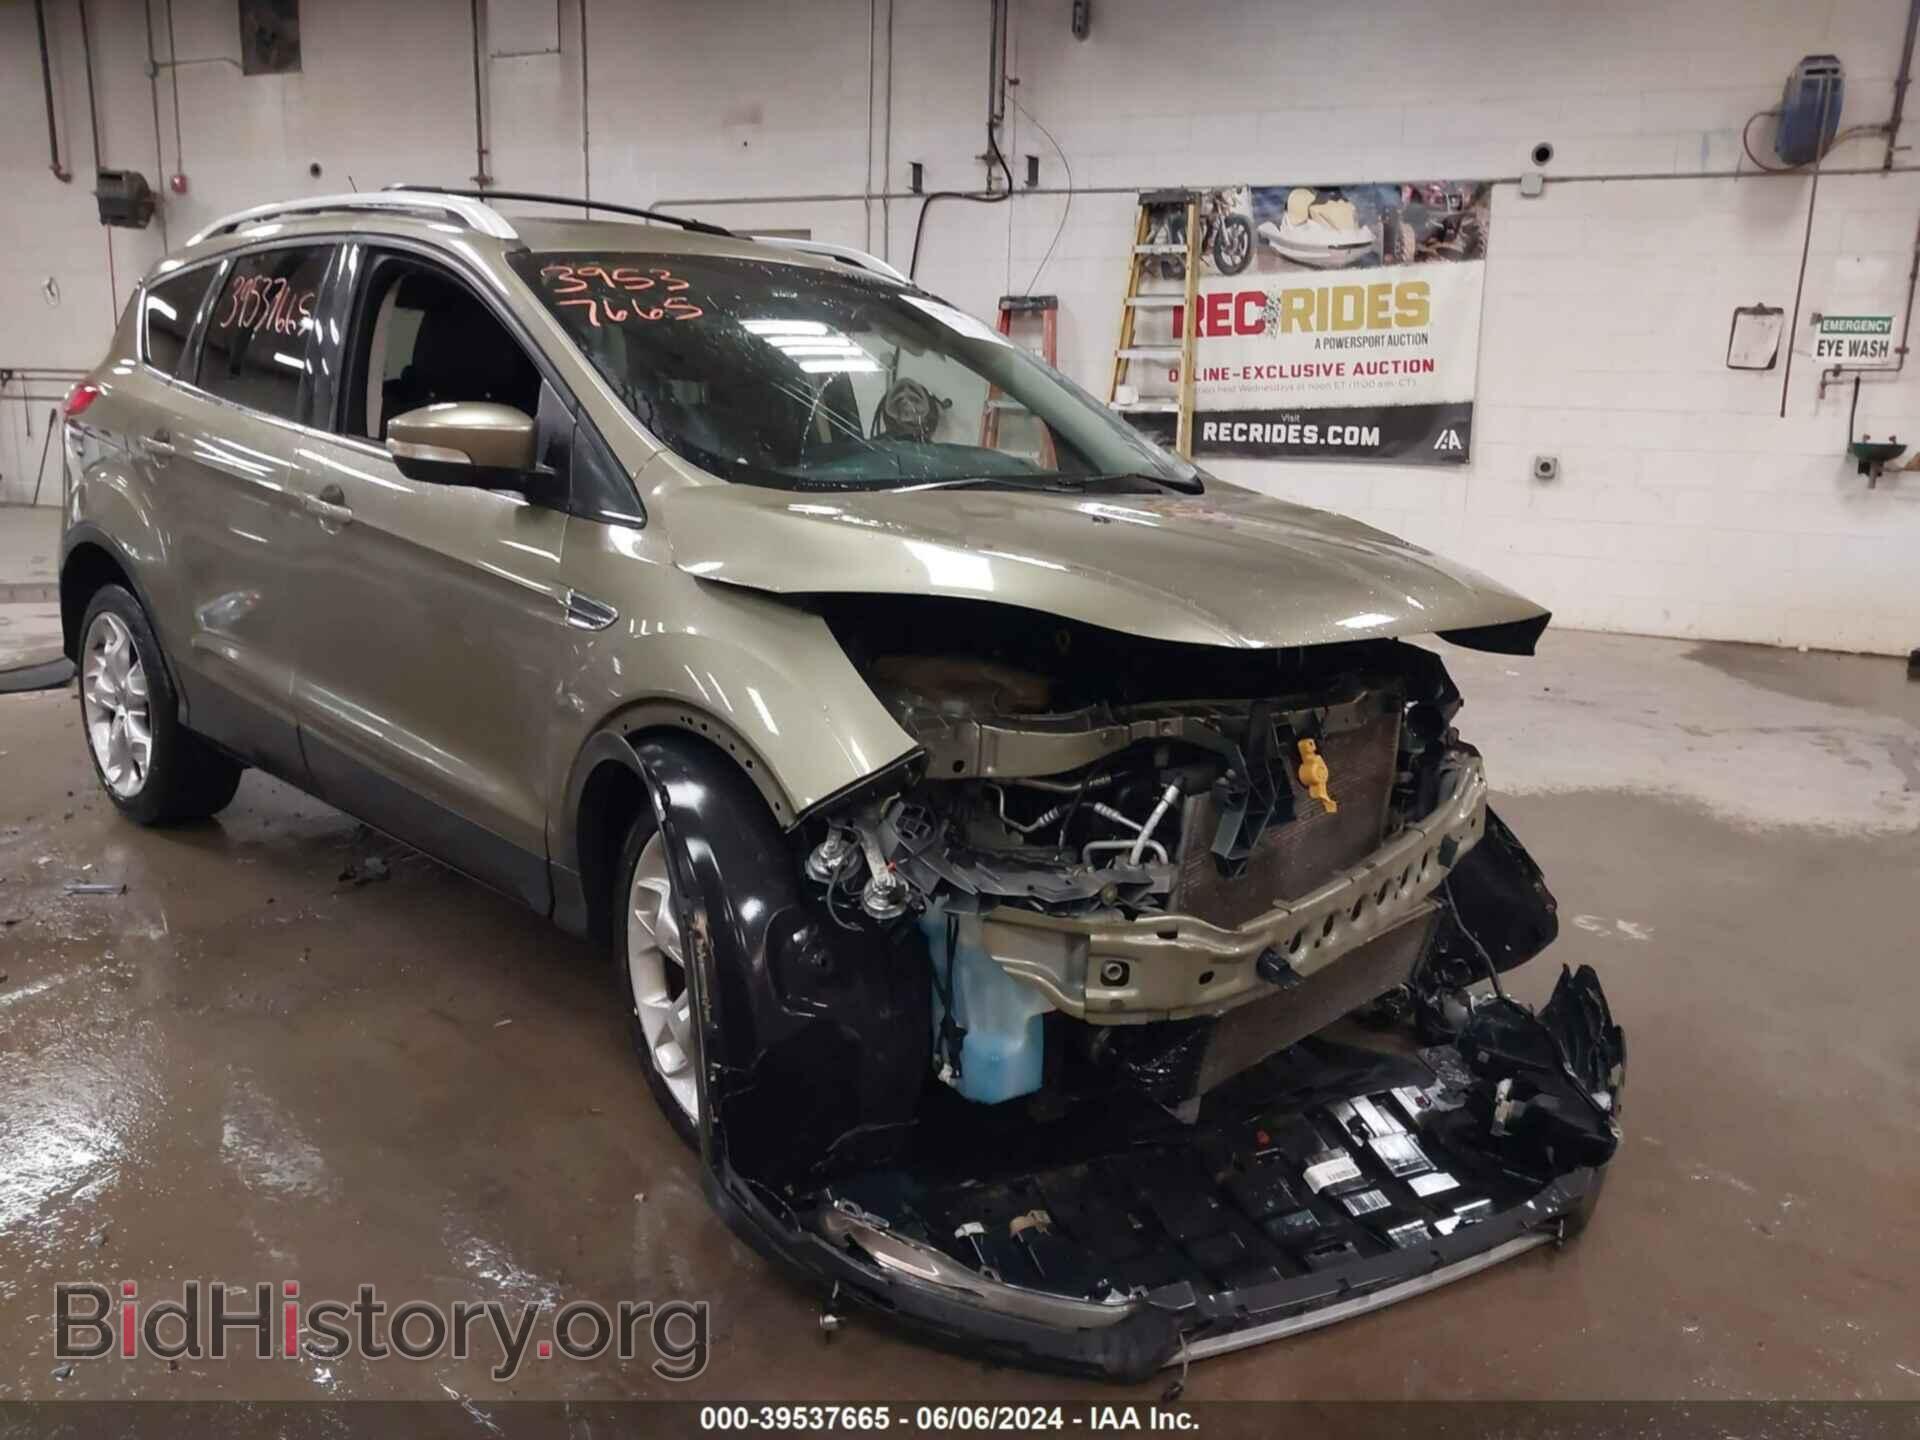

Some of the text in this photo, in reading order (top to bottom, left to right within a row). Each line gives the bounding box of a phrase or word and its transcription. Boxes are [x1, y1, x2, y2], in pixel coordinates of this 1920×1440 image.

[540, 265, 690, 293] 3953
[557, 297, 704, 327] 7665
[1281, 281, 1431, 333] RIDES
[1822, 319, 1890, 332] EMERGENCY
[1314, 332, 1429, 350] A POWERSPORT AUCTION
[1817, 340, 1890, 358] EYE WASH
[1168, 358, 1435, 383] OLINE-EXCLUSIVE AUCTION
[1281, 413, 1301, 422] Visit
[1203, 422, 1380, 447] RECRIDES.COM
